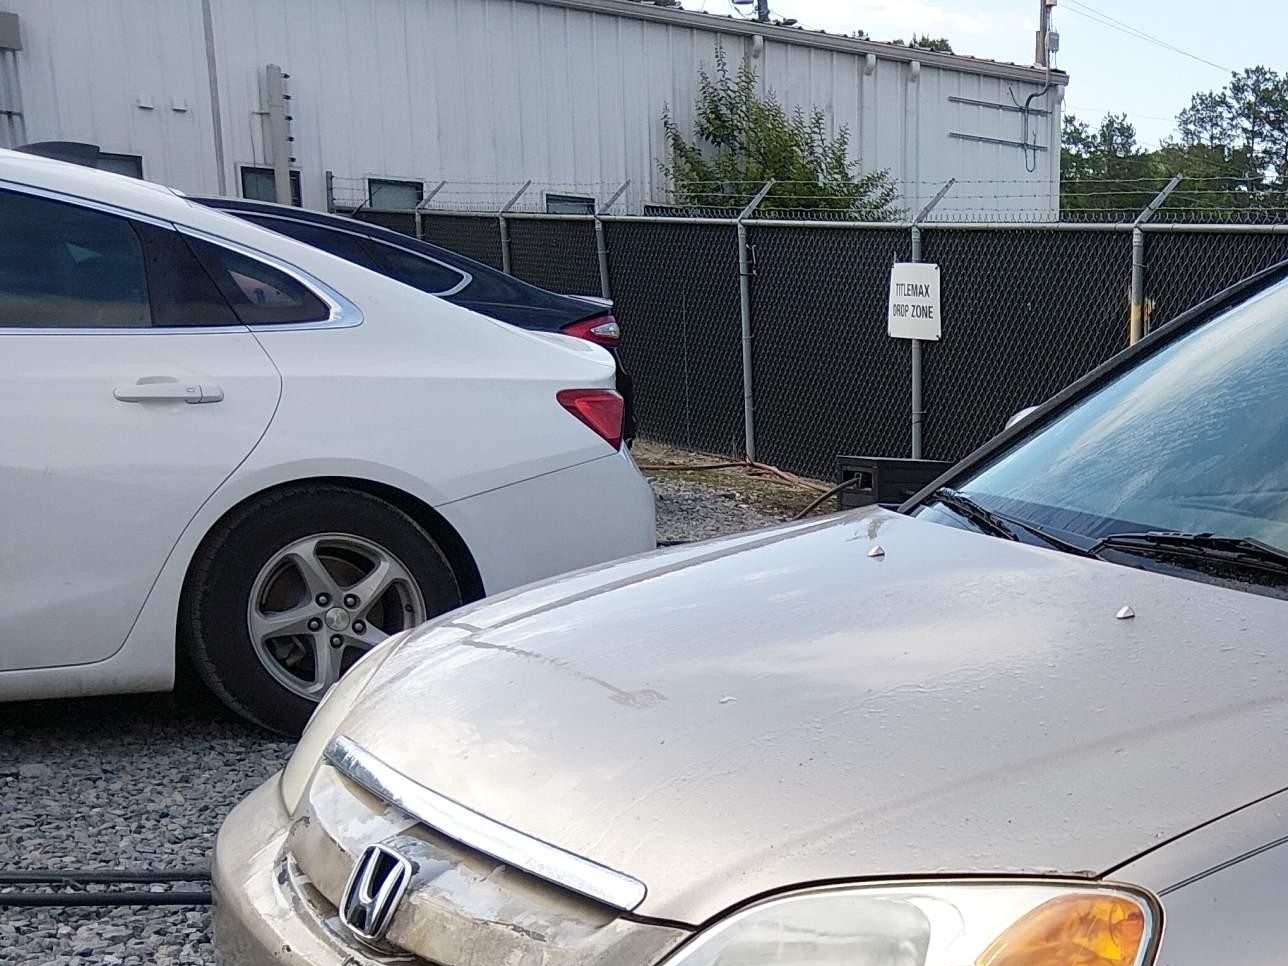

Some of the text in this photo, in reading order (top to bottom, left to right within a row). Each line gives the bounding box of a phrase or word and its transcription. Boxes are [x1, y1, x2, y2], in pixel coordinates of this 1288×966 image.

[895, 283, 930, 298] TITLEMAX
[892, 304, 934, 319] DROP ZONE
